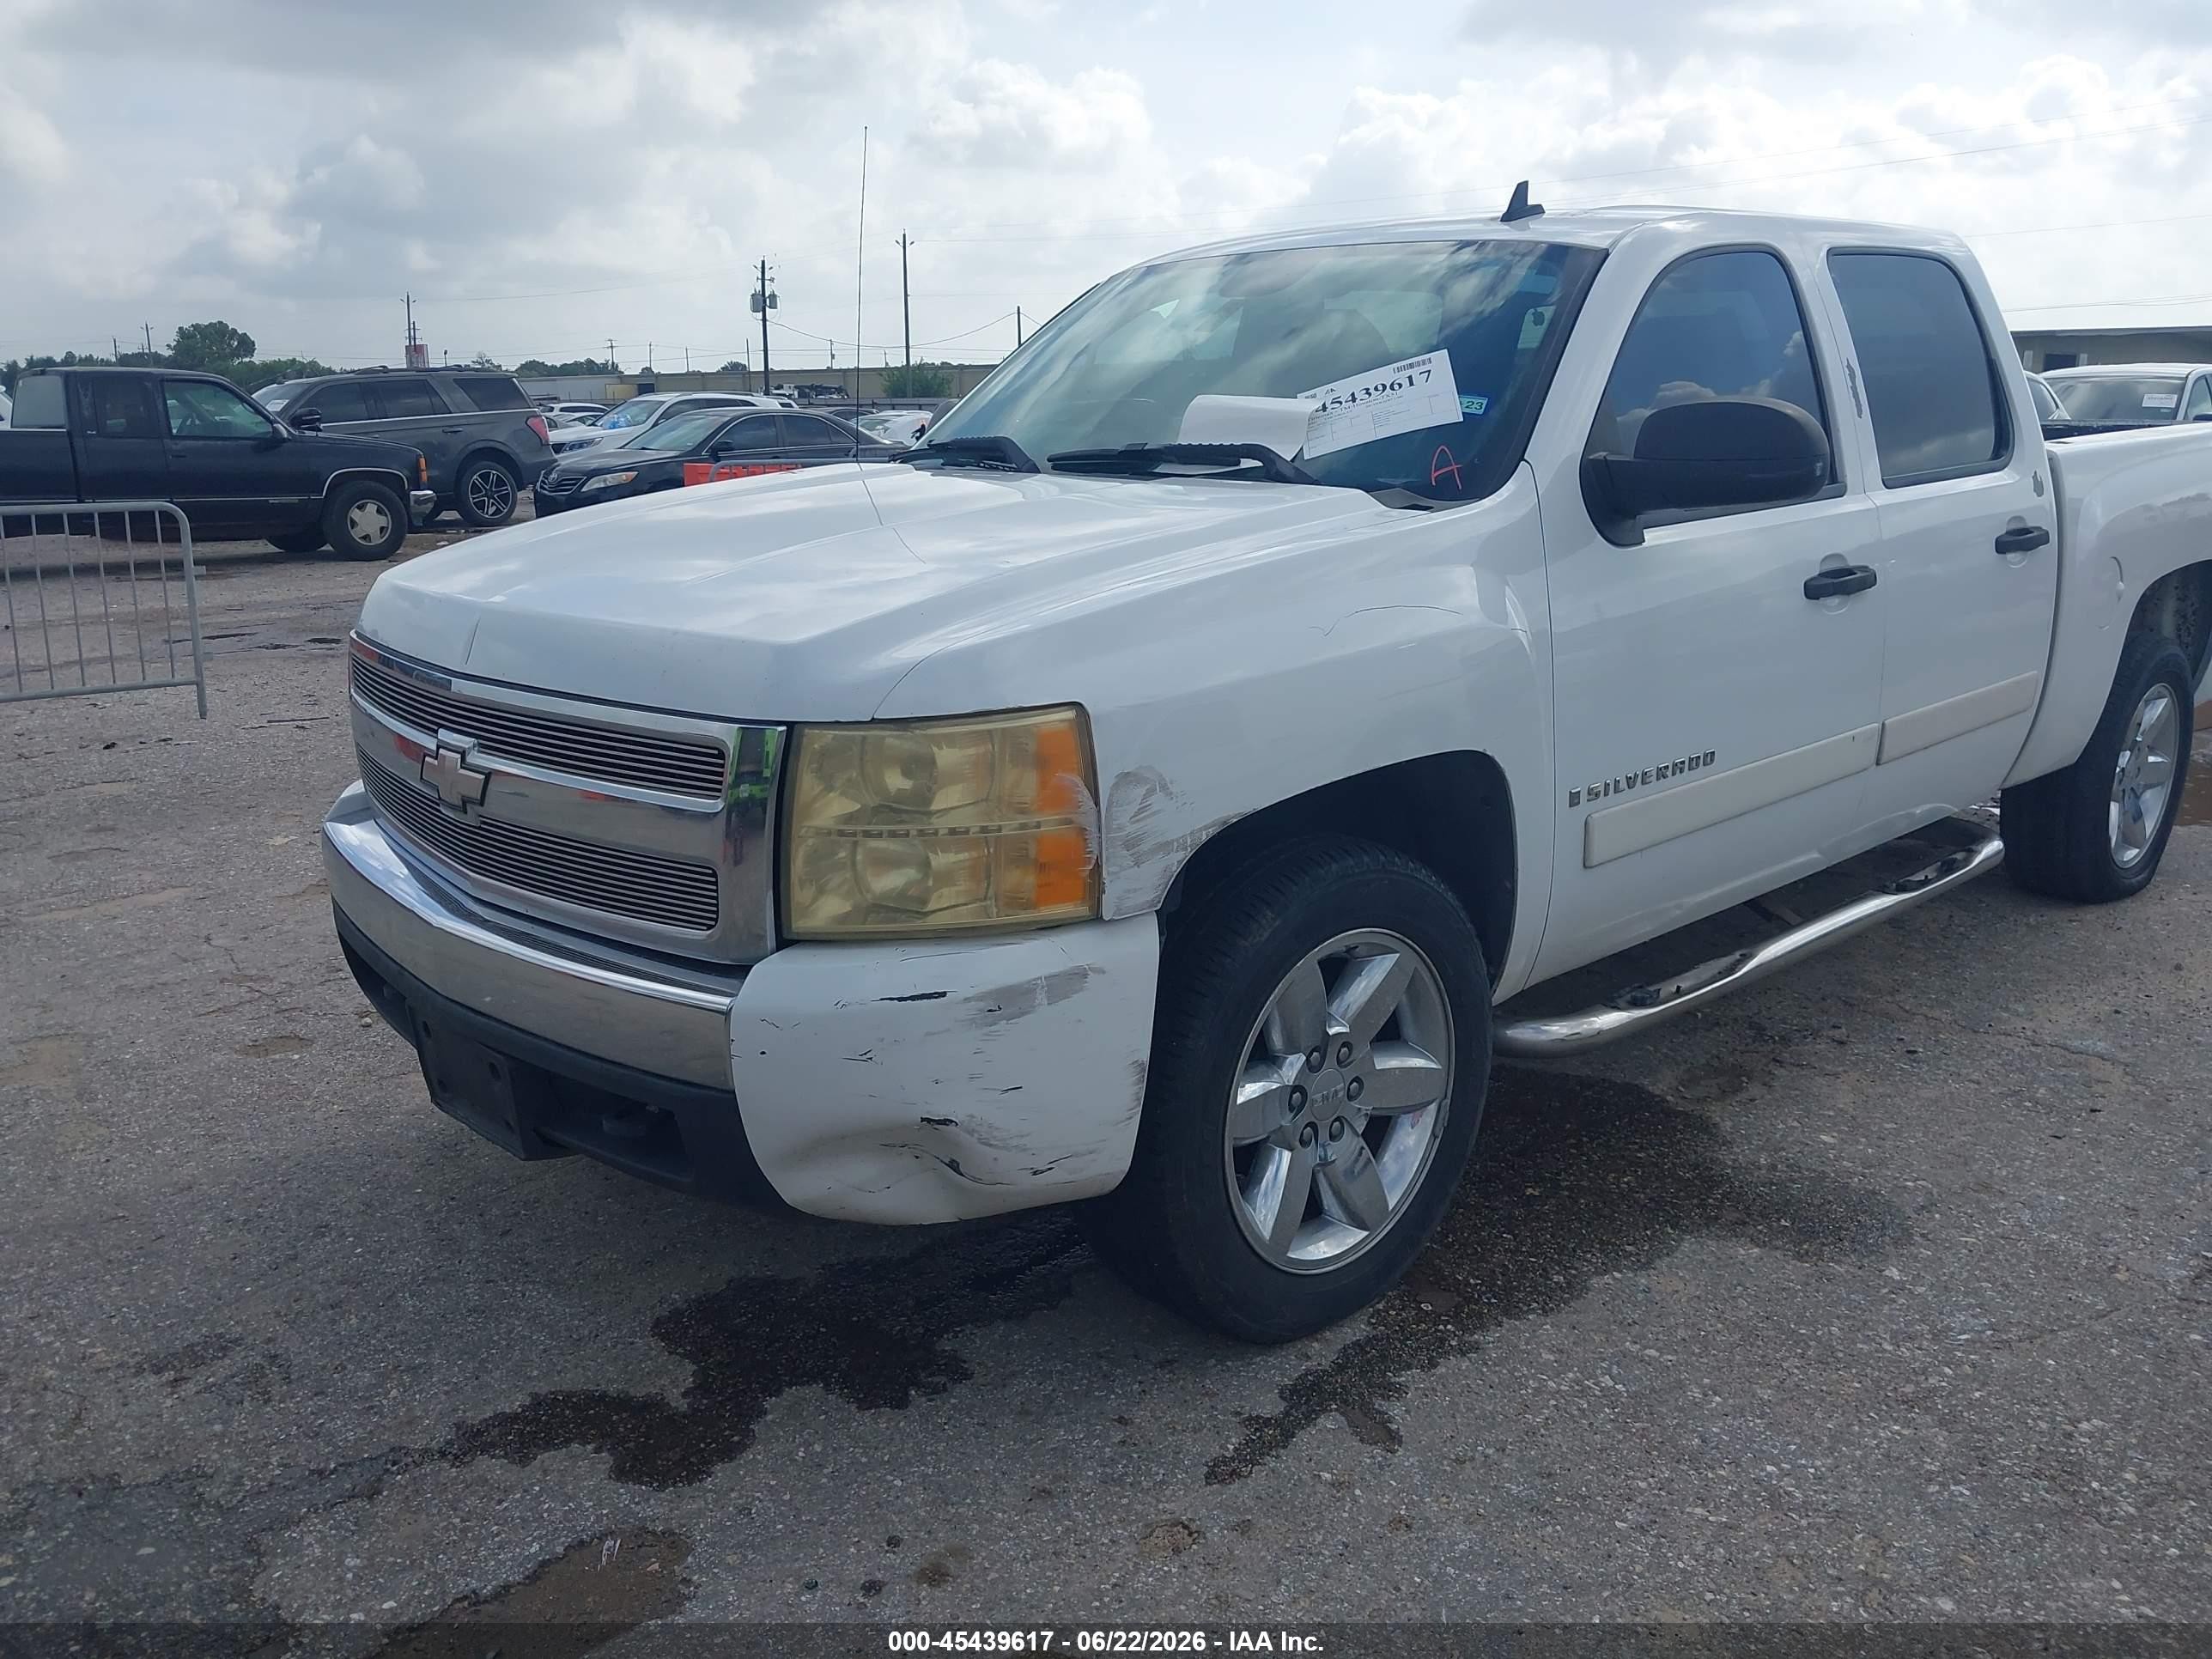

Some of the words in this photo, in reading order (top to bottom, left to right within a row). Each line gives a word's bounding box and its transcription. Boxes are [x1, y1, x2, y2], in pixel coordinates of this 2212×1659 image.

[1315, 369, 1432, 413] 45439617
[1465, 400, 1484, 410] 23
[1431, 445, 1463, 490] A
[1586, 748, 1716, 802] SILVERADO
